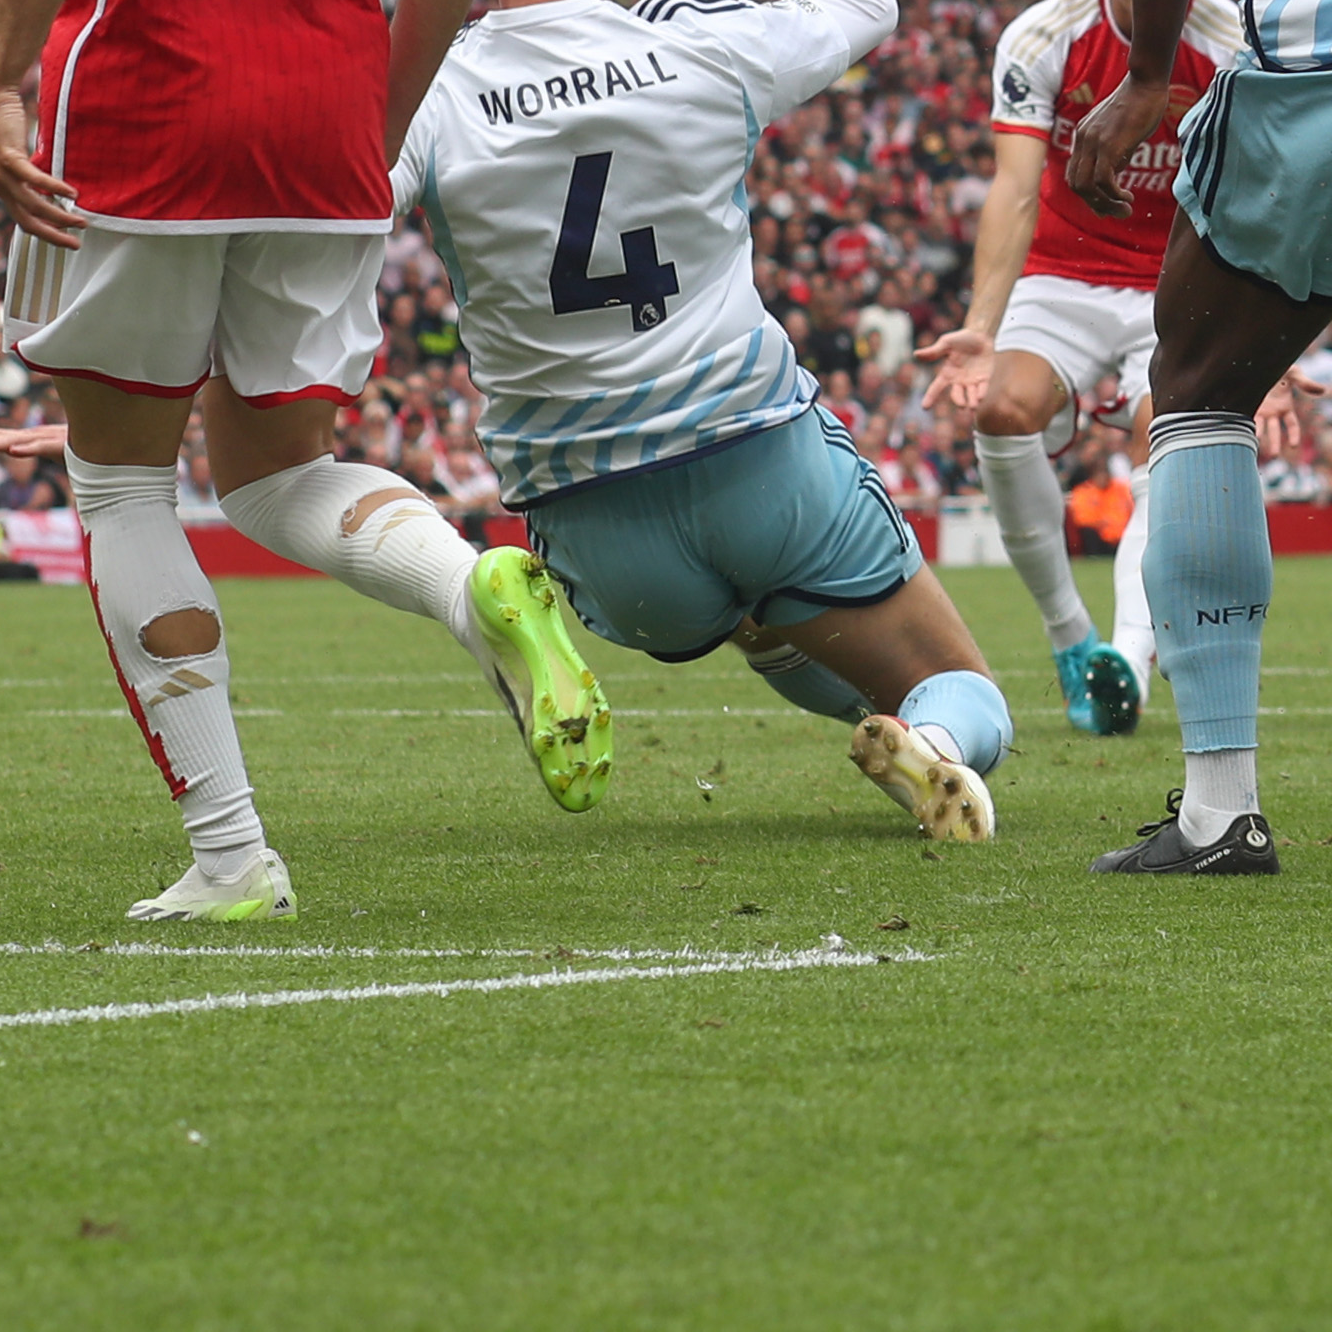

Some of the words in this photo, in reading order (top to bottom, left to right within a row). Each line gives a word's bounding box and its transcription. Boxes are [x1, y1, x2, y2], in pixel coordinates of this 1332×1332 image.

[478, 51, 679, 126] WORRALL
[548, 149, 681, 334] 4
[1193, 847, 1231, 871] TIEMPO
